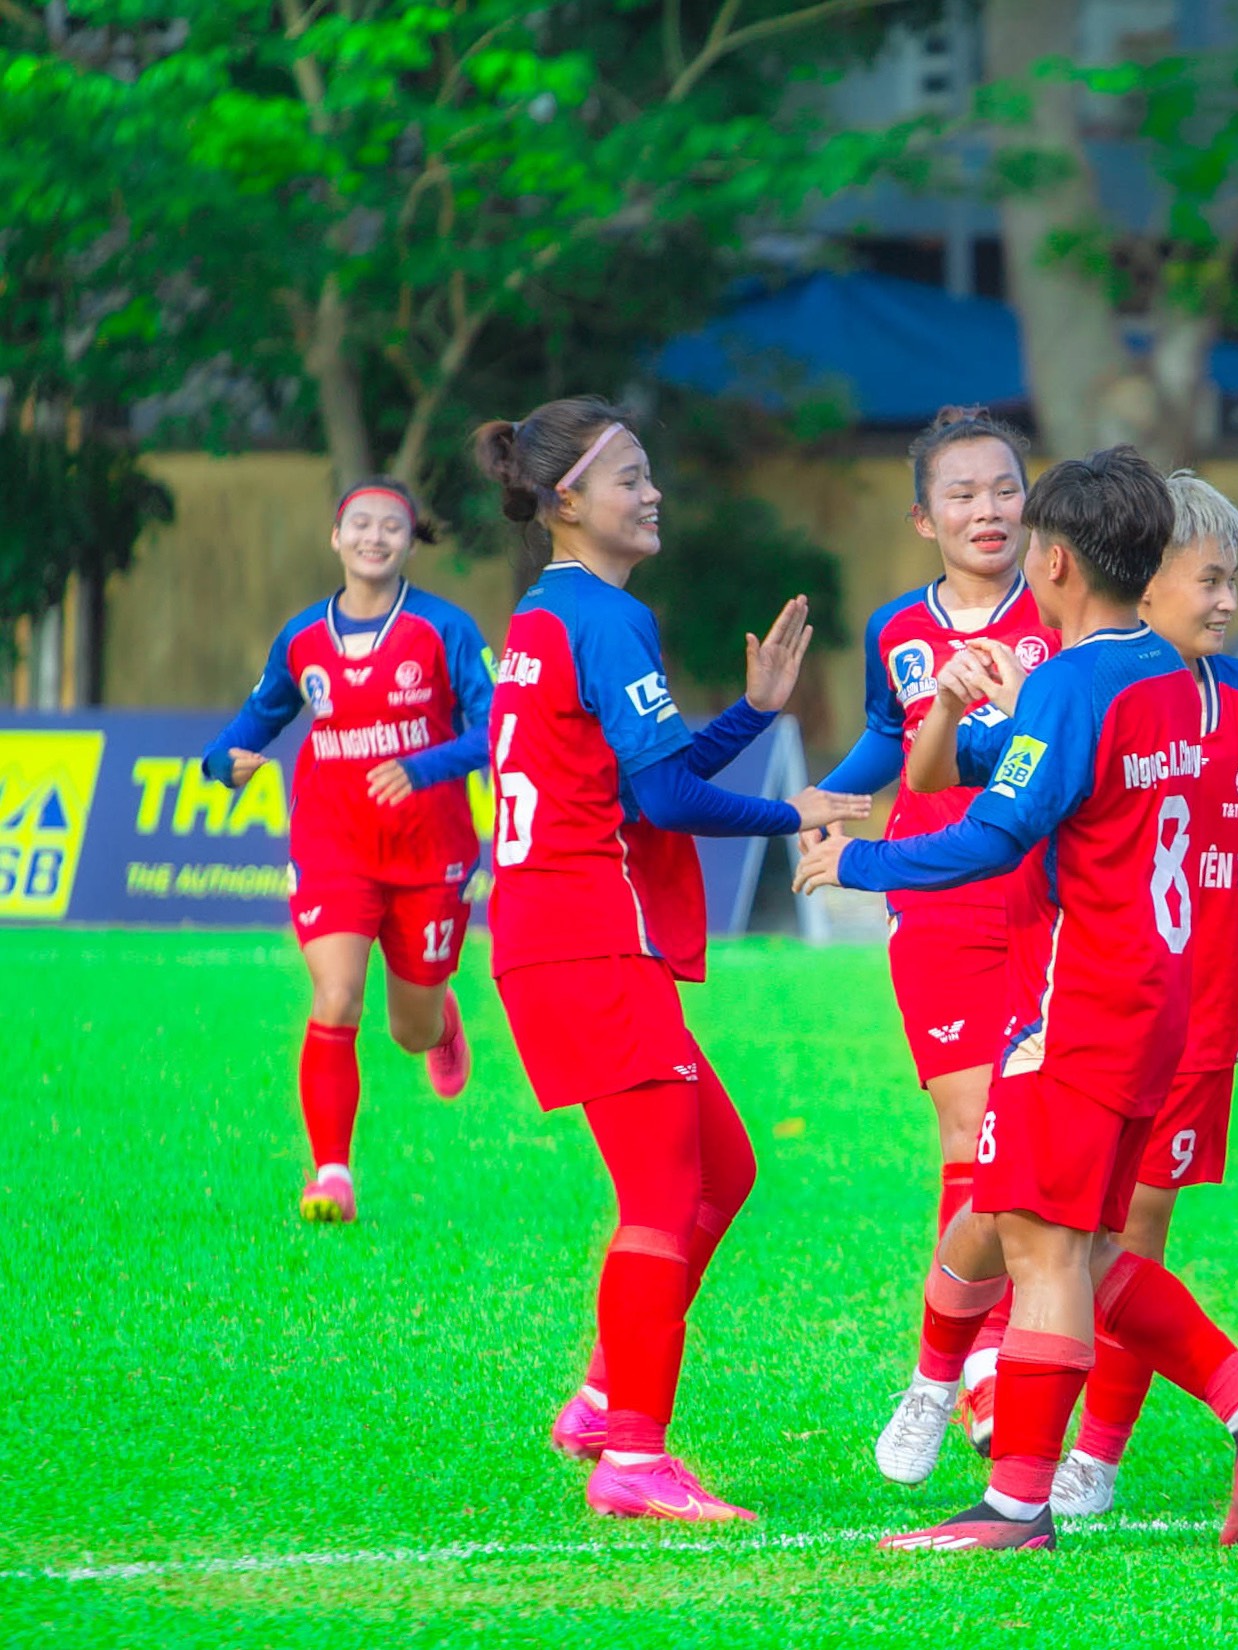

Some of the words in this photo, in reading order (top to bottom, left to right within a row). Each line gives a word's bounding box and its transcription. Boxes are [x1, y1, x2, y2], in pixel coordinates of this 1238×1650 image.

[400, 716, 431, 752] T&T
[494, 713, 539, 867] 6
[1122, 750, 1169, 790] Ngọc
[1150, 794, 1192, 954] 8
[422, 918, 455, 963] 12
[977, 1110, 996, 1165] 8
[1171, 1129, 1197, 1180] 9
